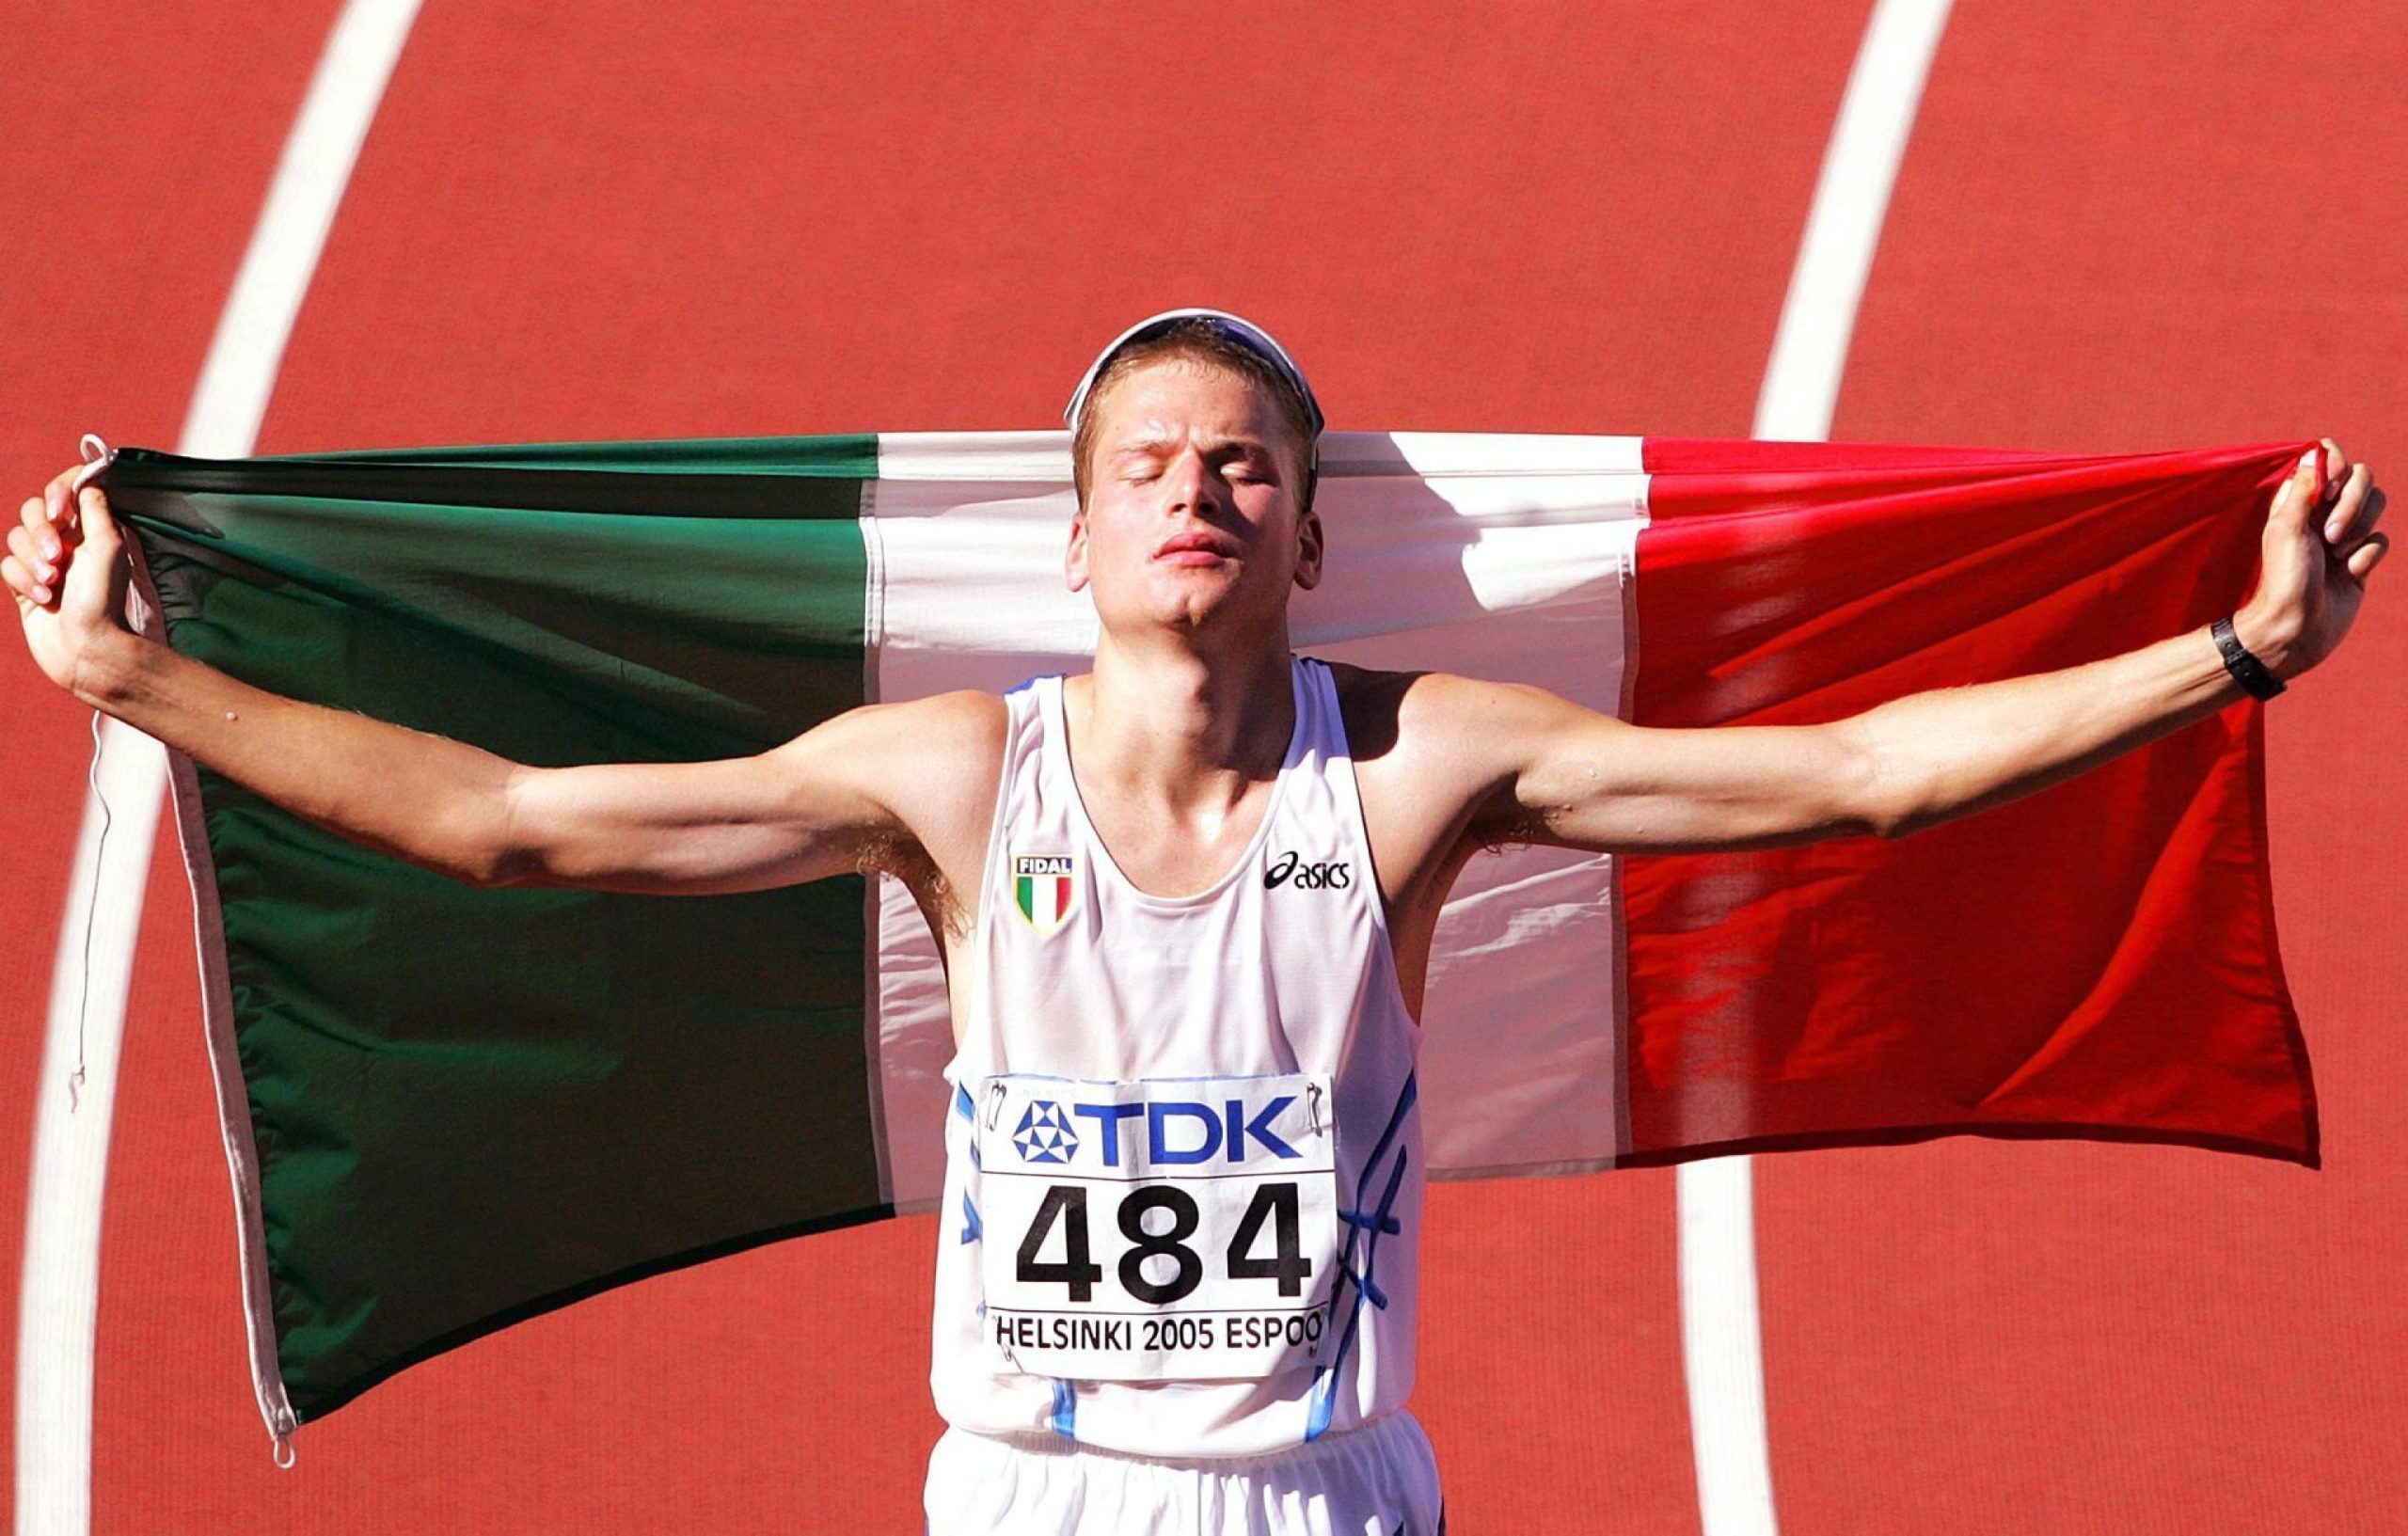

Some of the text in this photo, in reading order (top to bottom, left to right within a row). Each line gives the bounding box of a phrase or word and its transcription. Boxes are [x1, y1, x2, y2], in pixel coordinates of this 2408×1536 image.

[1020, 857, 1071, 874] FIDAL
[1294, 863, 1350, 889] asics
[1073, 1096, 1304, 1166] TDK
[1016, 1182, 1312, 1305] 484
[996, 1311, 1323, 1351] HELSINKI 2005 ESPOO
